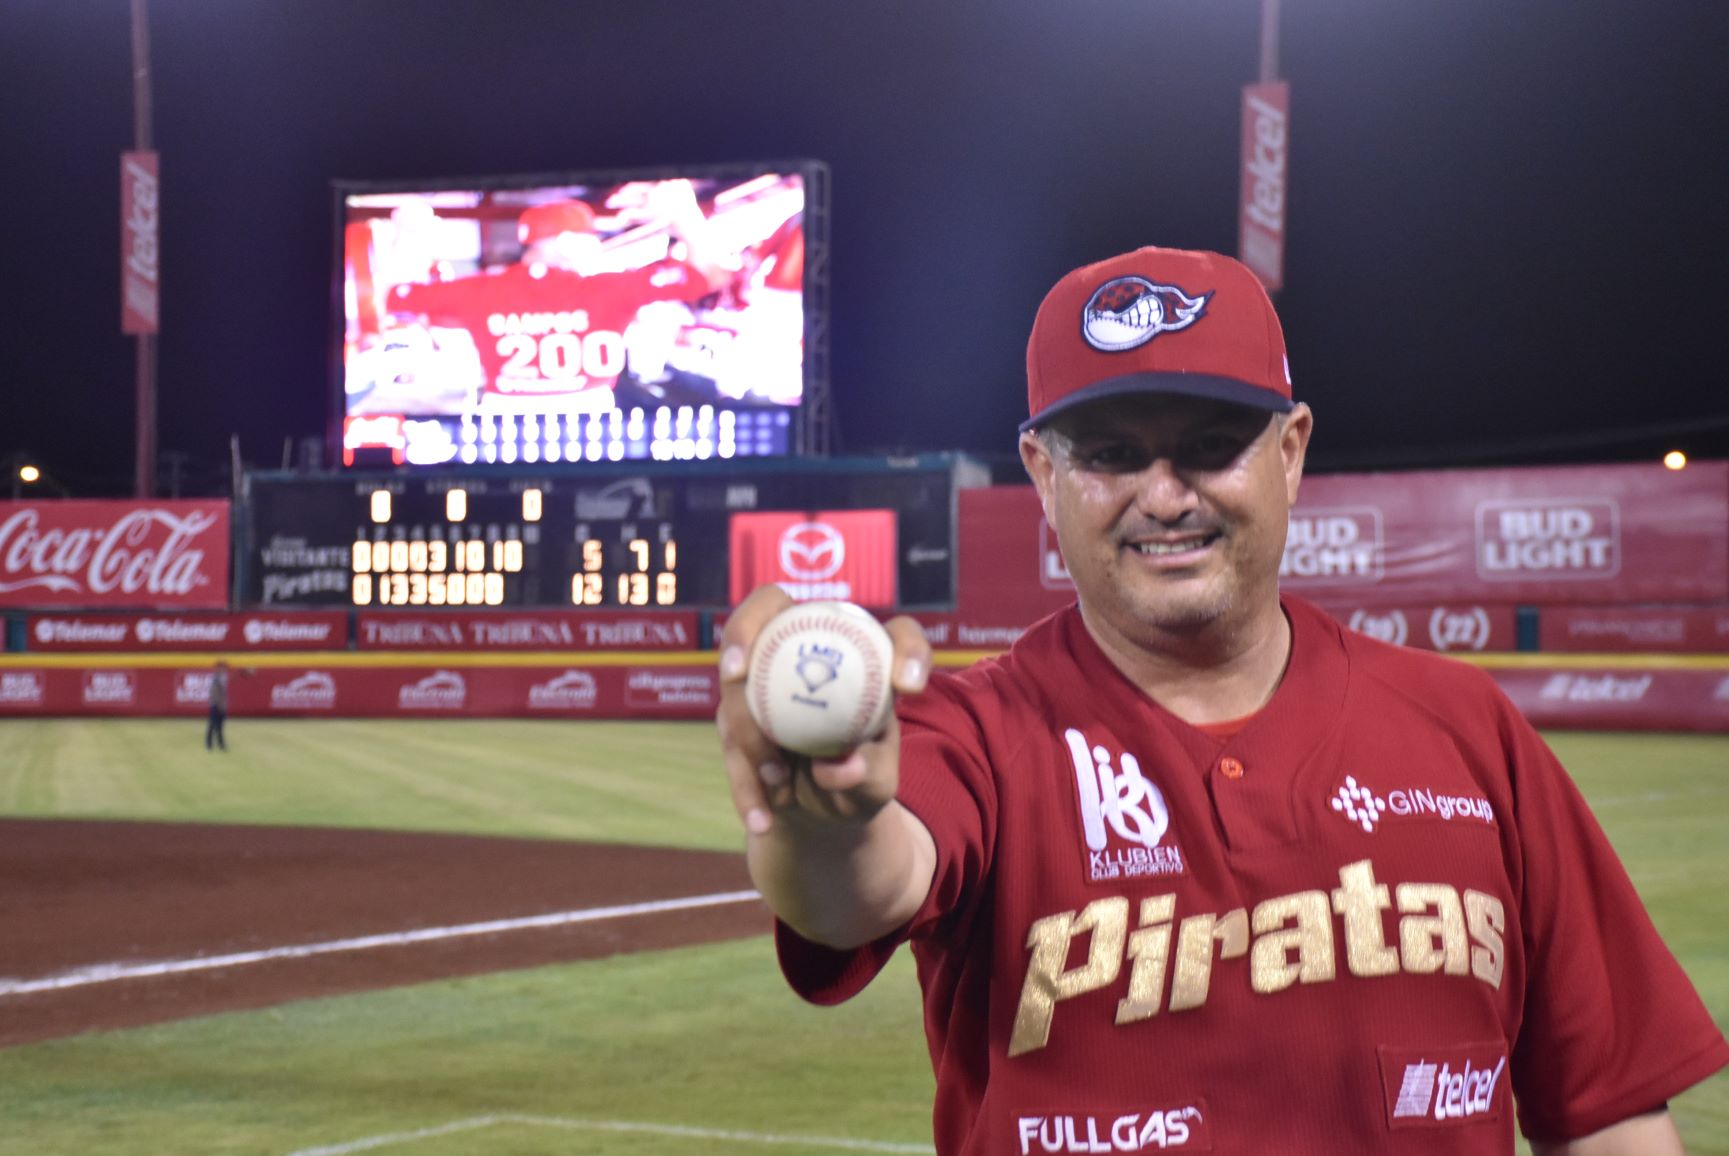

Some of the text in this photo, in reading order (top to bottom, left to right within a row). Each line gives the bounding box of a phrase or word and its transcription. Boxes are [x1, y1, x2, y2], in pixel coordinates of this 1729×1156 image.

[496, 330, 626, 378] 200
[522, 489, 542, 521] 0
[1500, 509, 1593, 539] BUD
[583, 539, 602, 571] 5
[629, 539, 649, 572] 7
[665, 539, 676, 571] 1
[1279, 545, 1373, 577] IGHT
[1485, 538, 1610, 570] LIGHT
[572, 573, 602, 605] 12
[618, 573, 649, 605] 13
[1388, 787, 1493, 824] GINgroup
[1090, 845, 1181, 869] KLUBIEN
[1124, 860, 1184, 877] DEPORTIVO
[1434, 1055, 1506, 1120] telcel
[1018, 1108, 1191, 1156] FULLGAS
